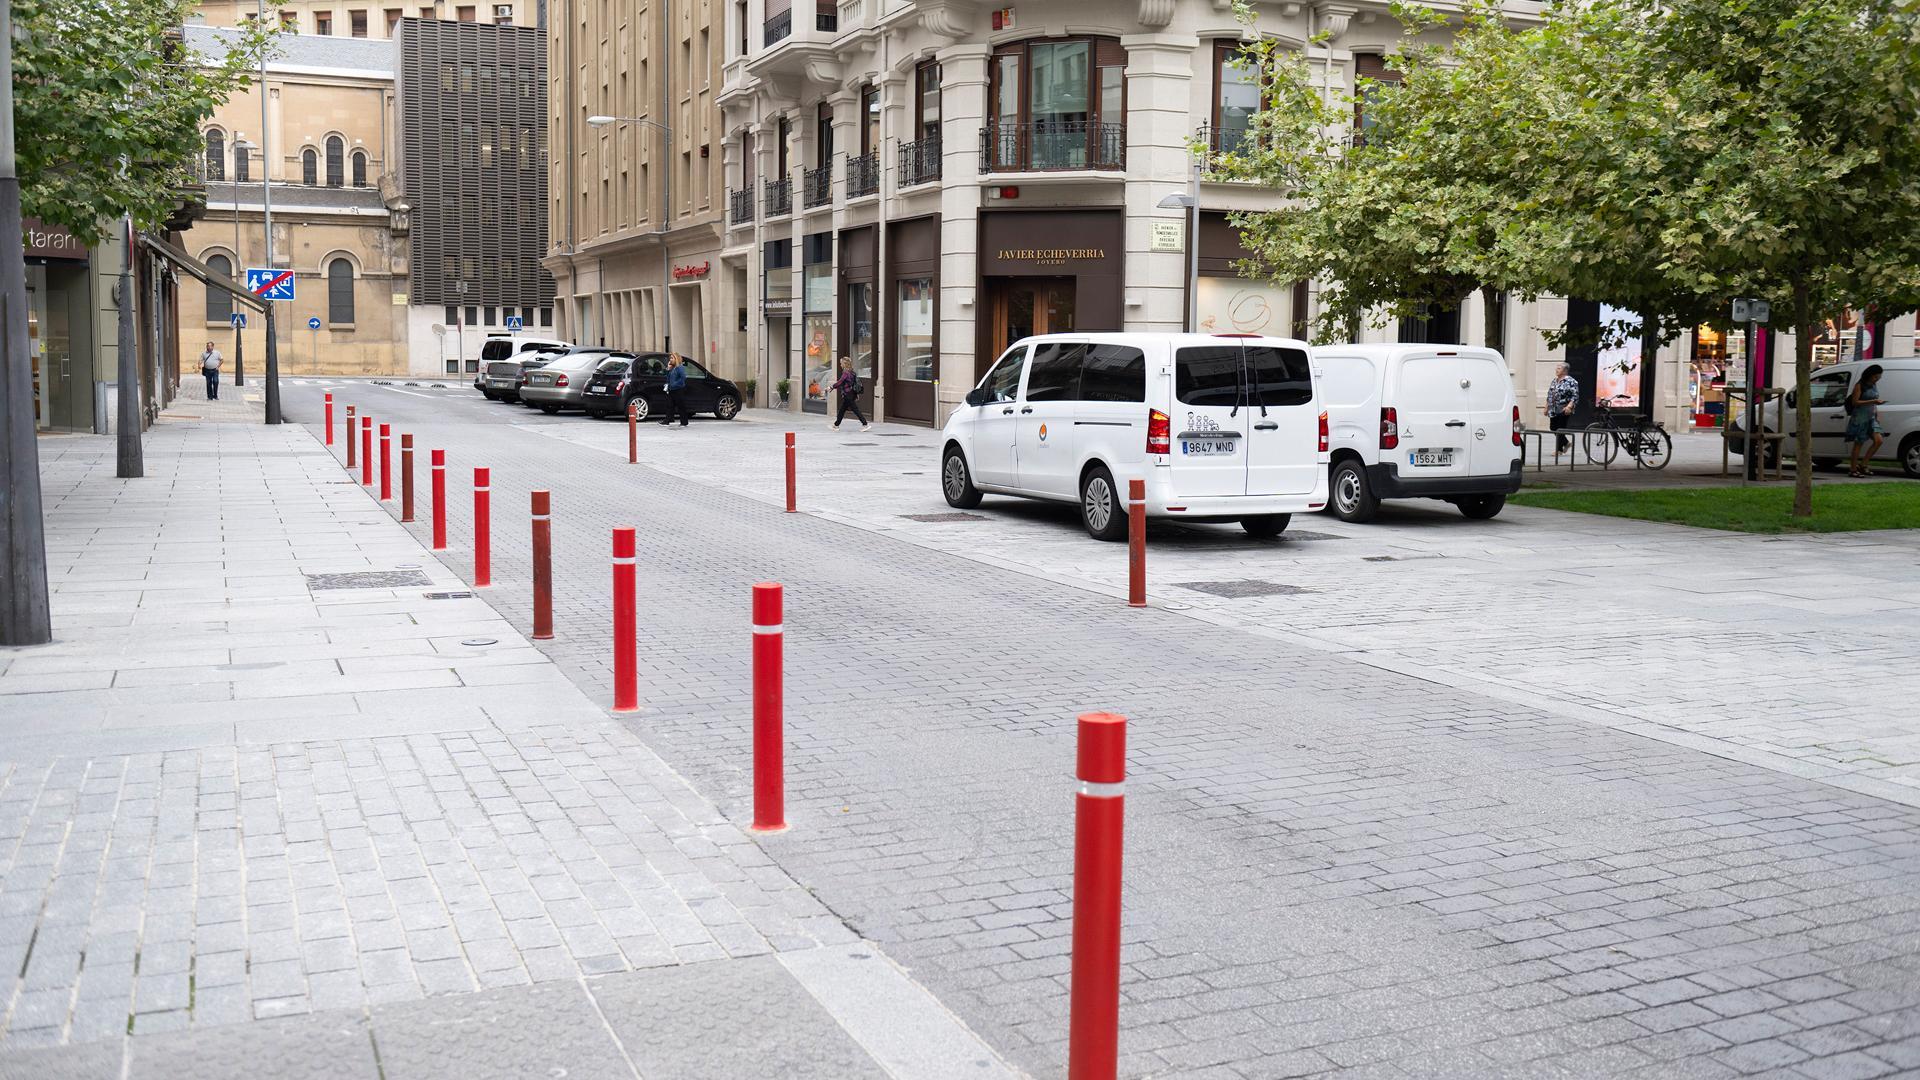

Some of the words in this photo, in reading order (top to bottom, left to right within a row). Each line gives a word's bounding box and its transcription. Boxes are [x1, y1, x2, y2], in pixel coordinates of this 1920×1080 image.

[998, 249, 1034, 259] JAVIER
[1036, 248, 1105, 259] ECHEVERRIA
[1189, 442, 1213, 453] 9647
[1215, 441, 1234, 452] MND
[1415, 454, 1436, 464] 1562
[1437, 454, 1453, 464] MHT
